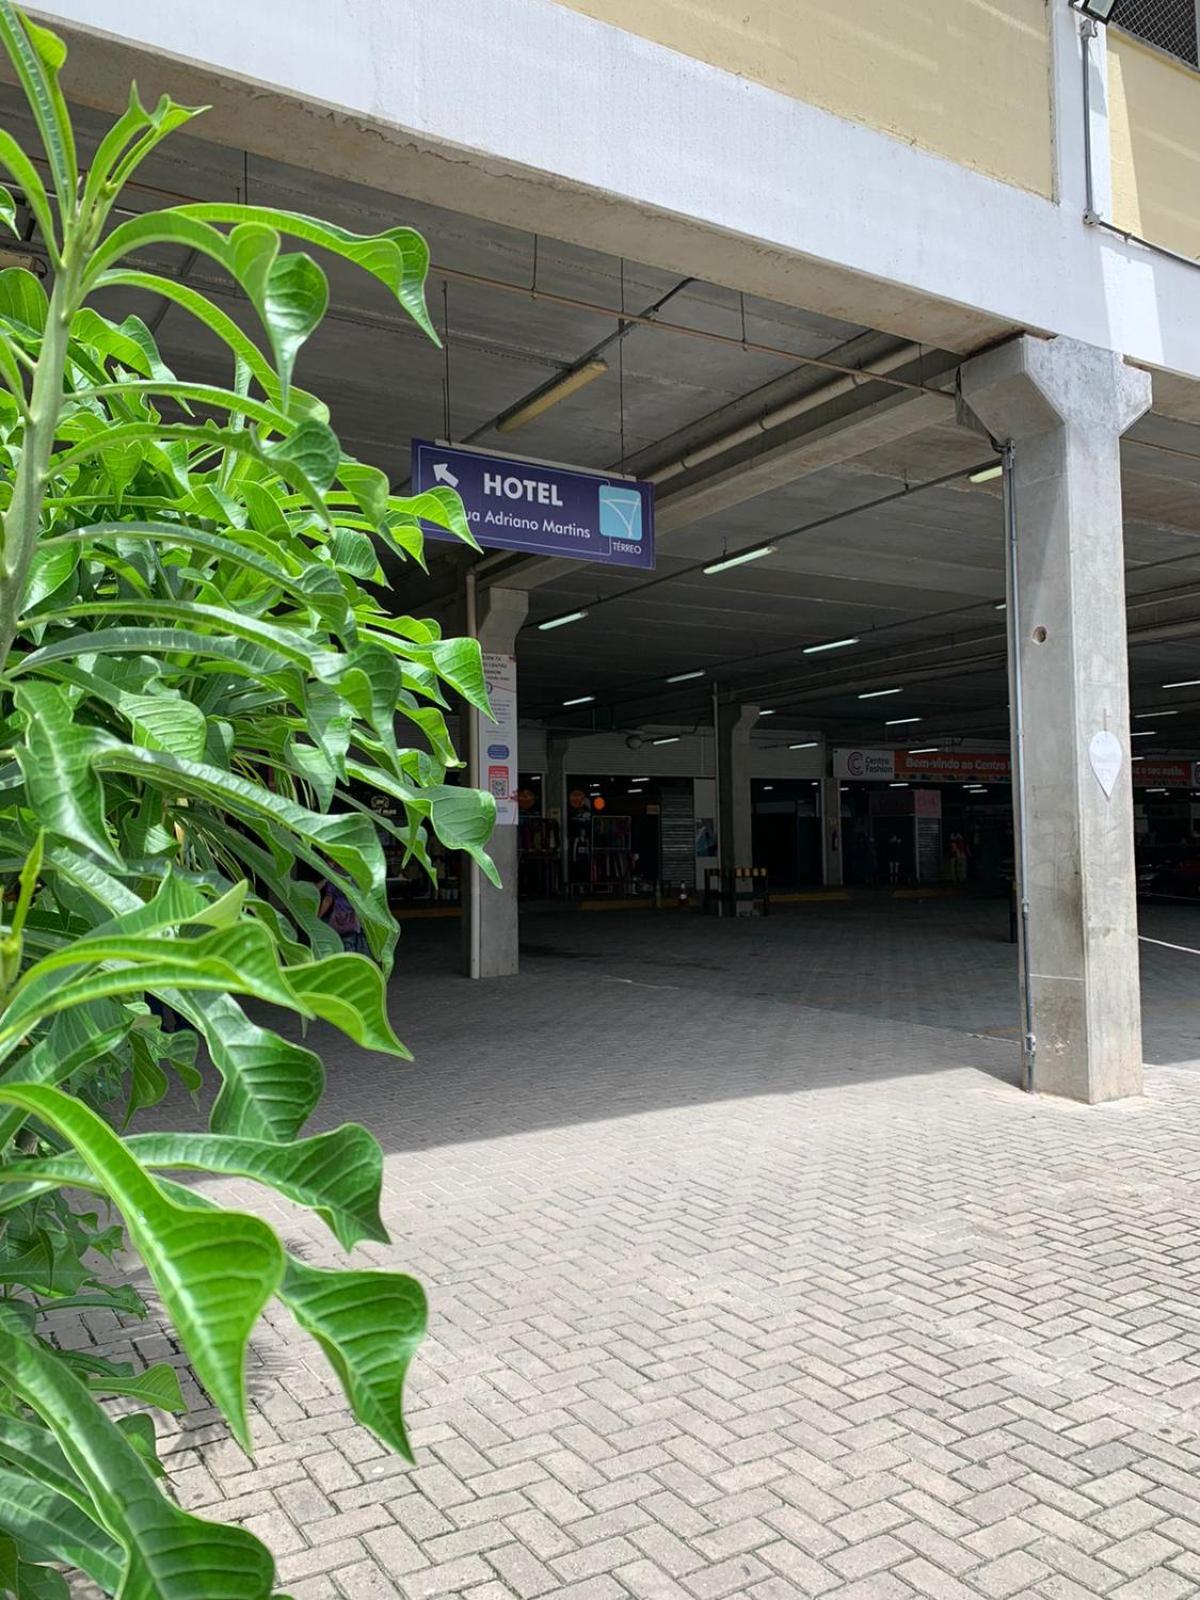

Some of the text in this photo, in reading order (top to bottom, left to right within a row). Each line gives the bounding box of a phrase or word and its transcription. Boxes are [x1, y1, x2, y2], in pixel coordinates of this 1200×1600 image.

[483, 472, 563, 506] HOTEL
[465, 510, 591, 539] ua Adriano Martins
[612, 541, 642, 554] TÉRREO
[905, 756, 960, 769] Bem-vindo
